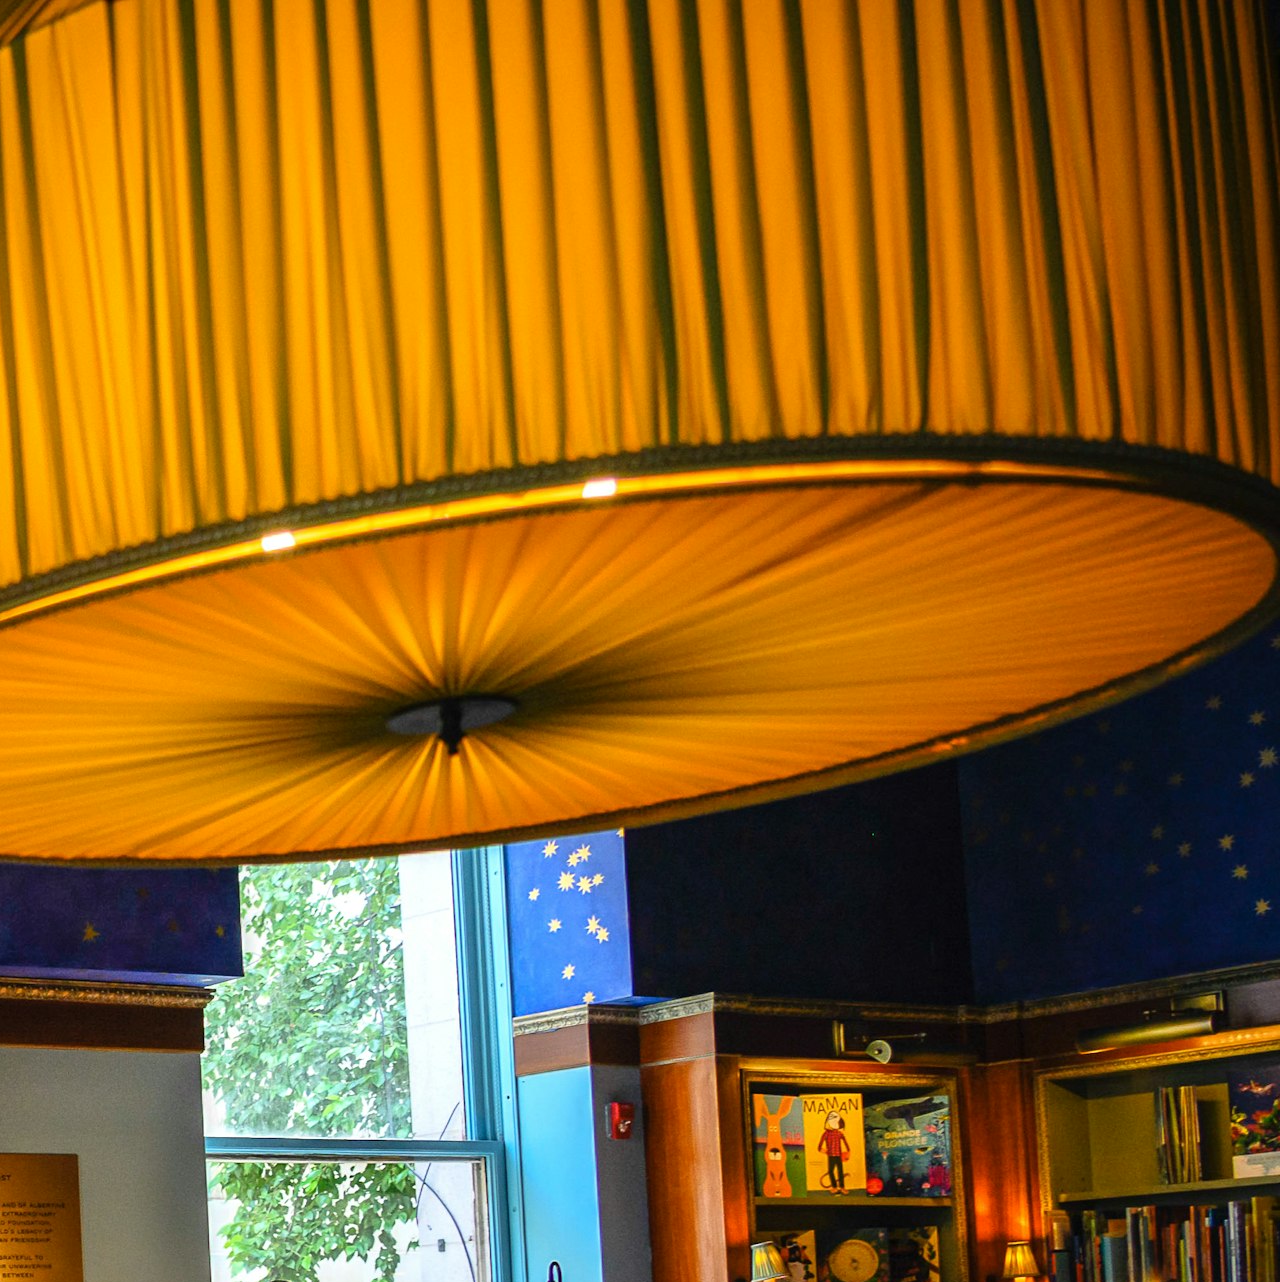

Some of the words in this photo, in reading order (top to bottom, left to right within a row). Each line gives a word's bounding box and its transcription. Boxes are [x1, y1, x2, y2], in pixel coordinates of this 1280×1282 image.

[803, 1096, 859, 1115] MAMAN
[884, 1129, 921, 1139] GRANDE
[878, 1136, 928, 1149] PLONGÉE
